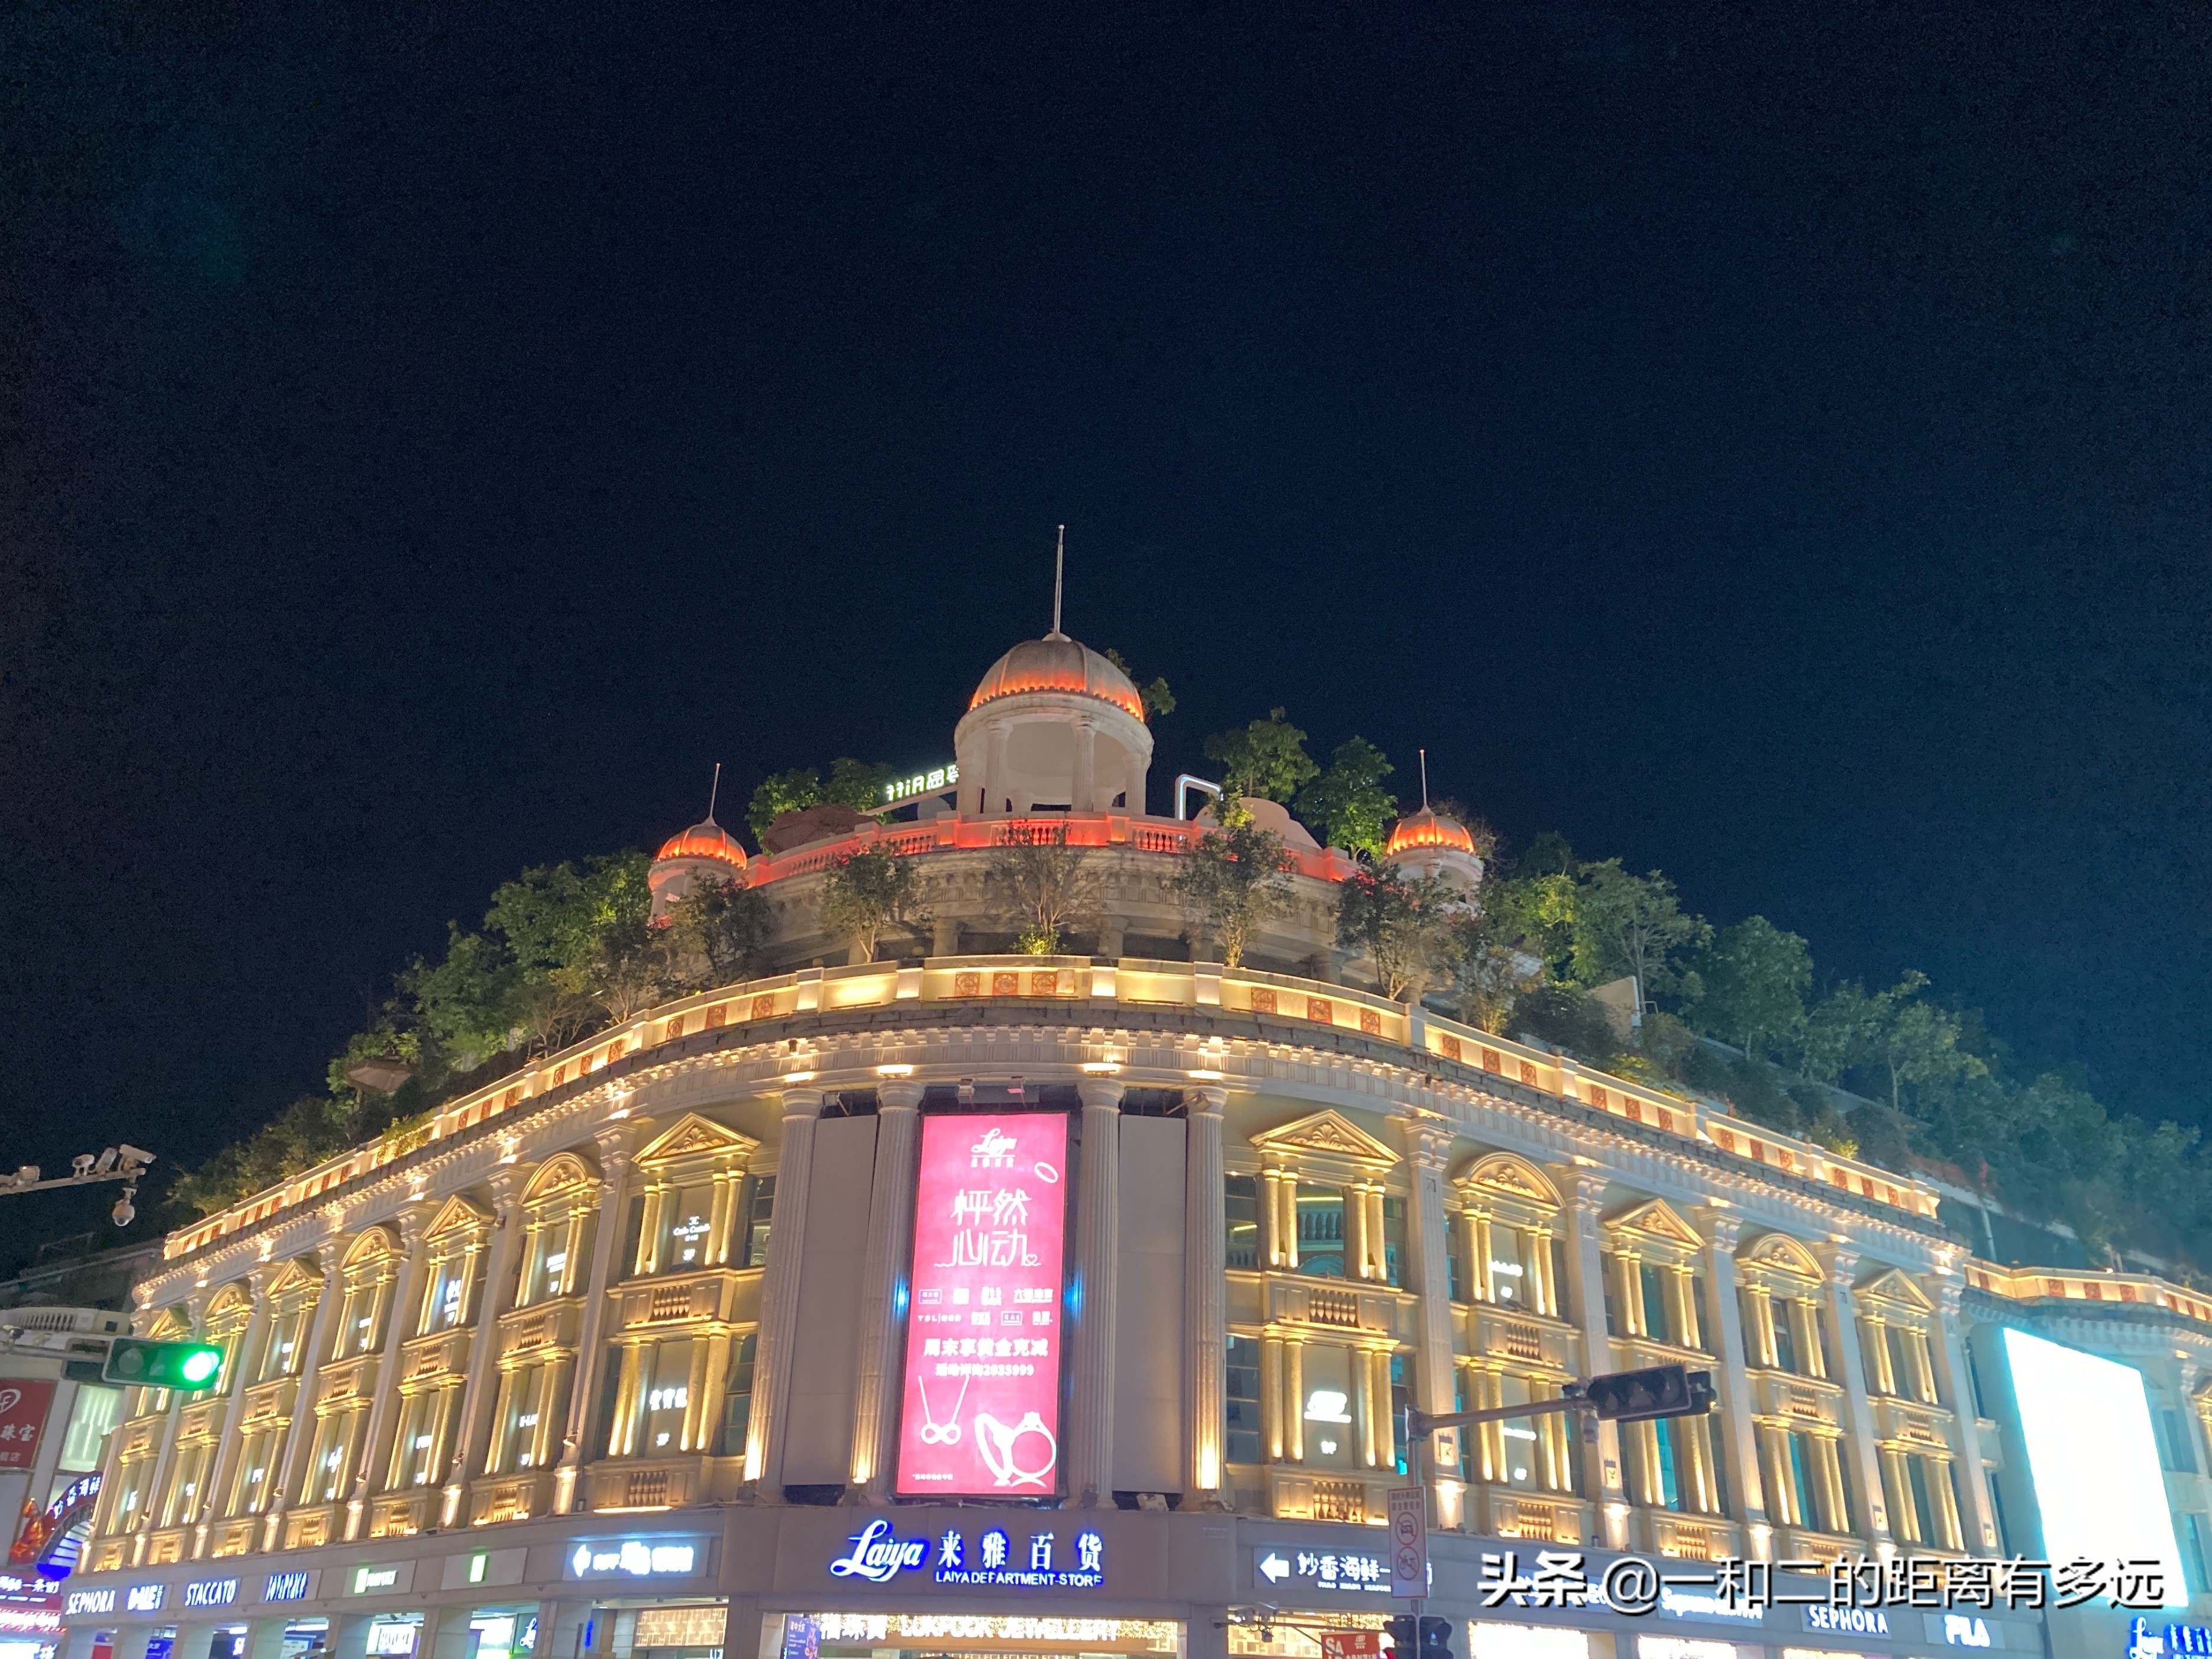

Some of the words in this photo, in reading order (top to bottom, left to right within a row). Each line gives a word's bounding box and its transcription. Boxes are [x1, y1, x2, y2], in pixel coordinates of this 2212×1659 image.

[951, 1188, 1032, 1227] 怦然
[934, 1228, 1031, 1267] 心动
[830, 1519, 925, 1582] Laiya
[938, 1530, 1102, 1571] 来雅百货
[66, 1590, 116, 1615] SEPHORA
[185, 1579, 237, 1606] STACCATO
[1808, 1604, 1889, 1634] SEPHORA
